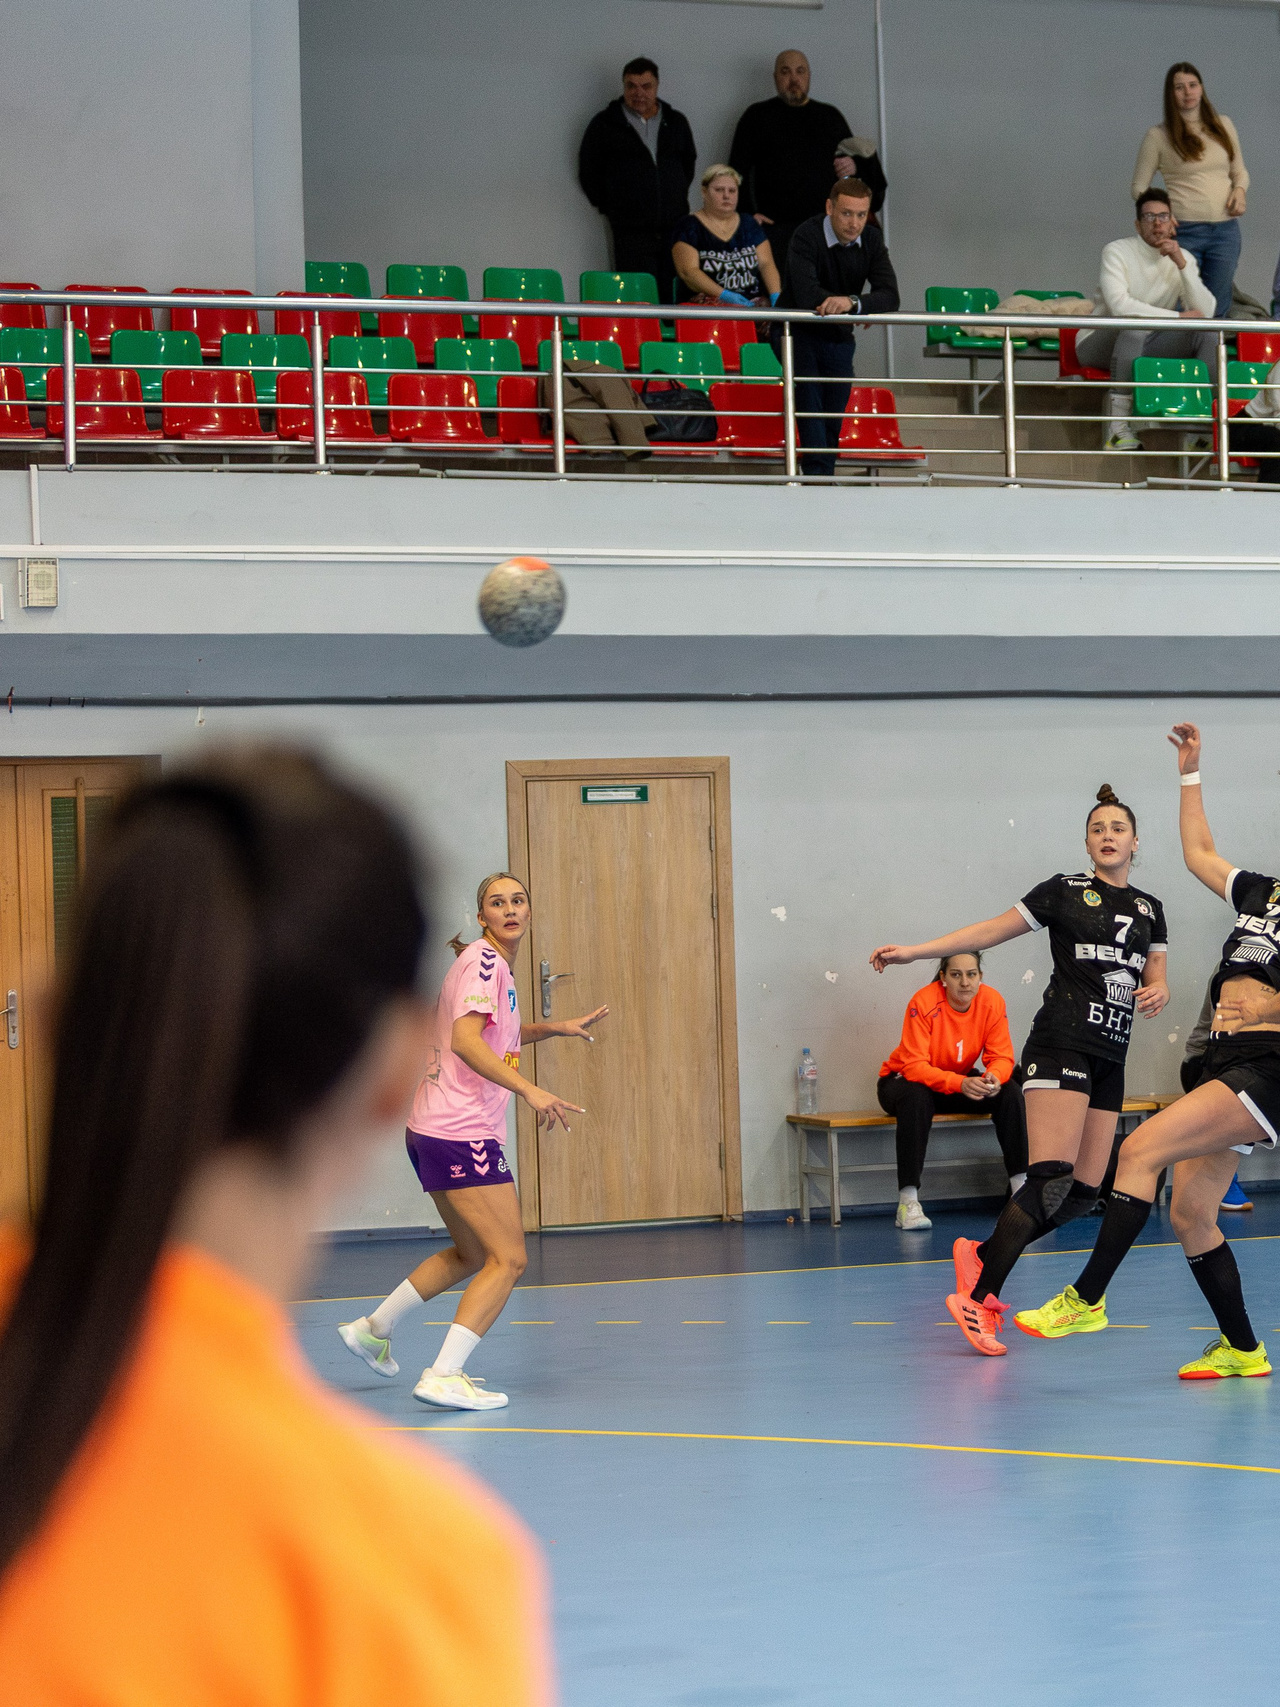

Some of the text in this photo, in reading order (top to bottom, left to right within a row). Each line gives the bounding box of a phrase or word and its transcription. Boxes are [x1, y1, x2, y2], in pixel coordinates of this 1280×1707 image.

[1067, 879, 1092, 888] Kempa
[1114, 914, 1133, 944] 7
[956, 1039, 964, 1063] 1
[1062, 1067, 1087, 1079] Kempa
